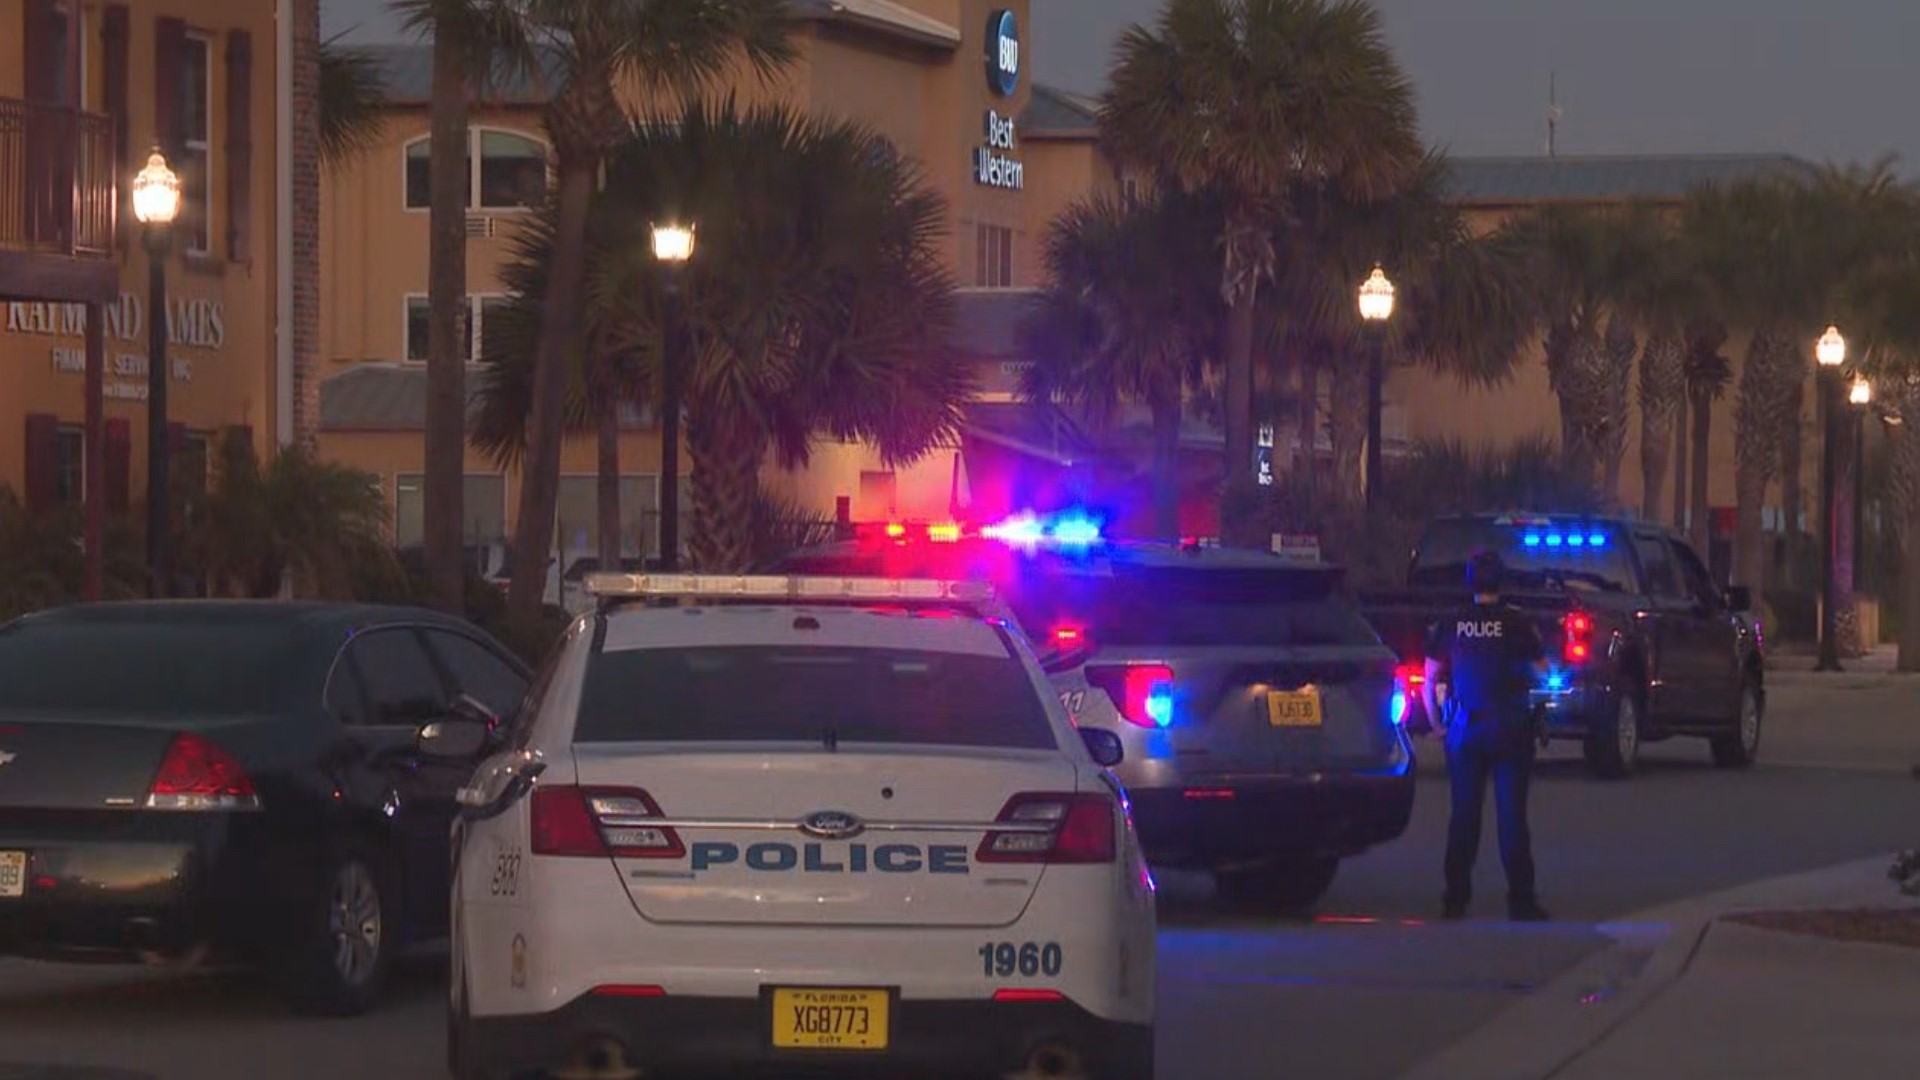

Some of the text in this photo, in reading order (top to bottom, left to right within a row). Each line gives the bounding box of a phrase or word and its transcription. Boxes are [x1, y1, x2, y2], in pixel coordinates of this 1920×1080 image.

[988, 110, 1014, 150] Best
[978, 147, 1024, 190] Western
[7, 293, 225, 348] RAYMND AMES
[1456, 621, 1503, 638] POLICE
[691, 842, 969, 874] POLICE
[978, 941, 1062, 977] 1960
[805, 993, 858, 1003] FLORIDA
[793, 1005, 869, 1035] XG8773
[817, 1036, 843, 1044] CITY
